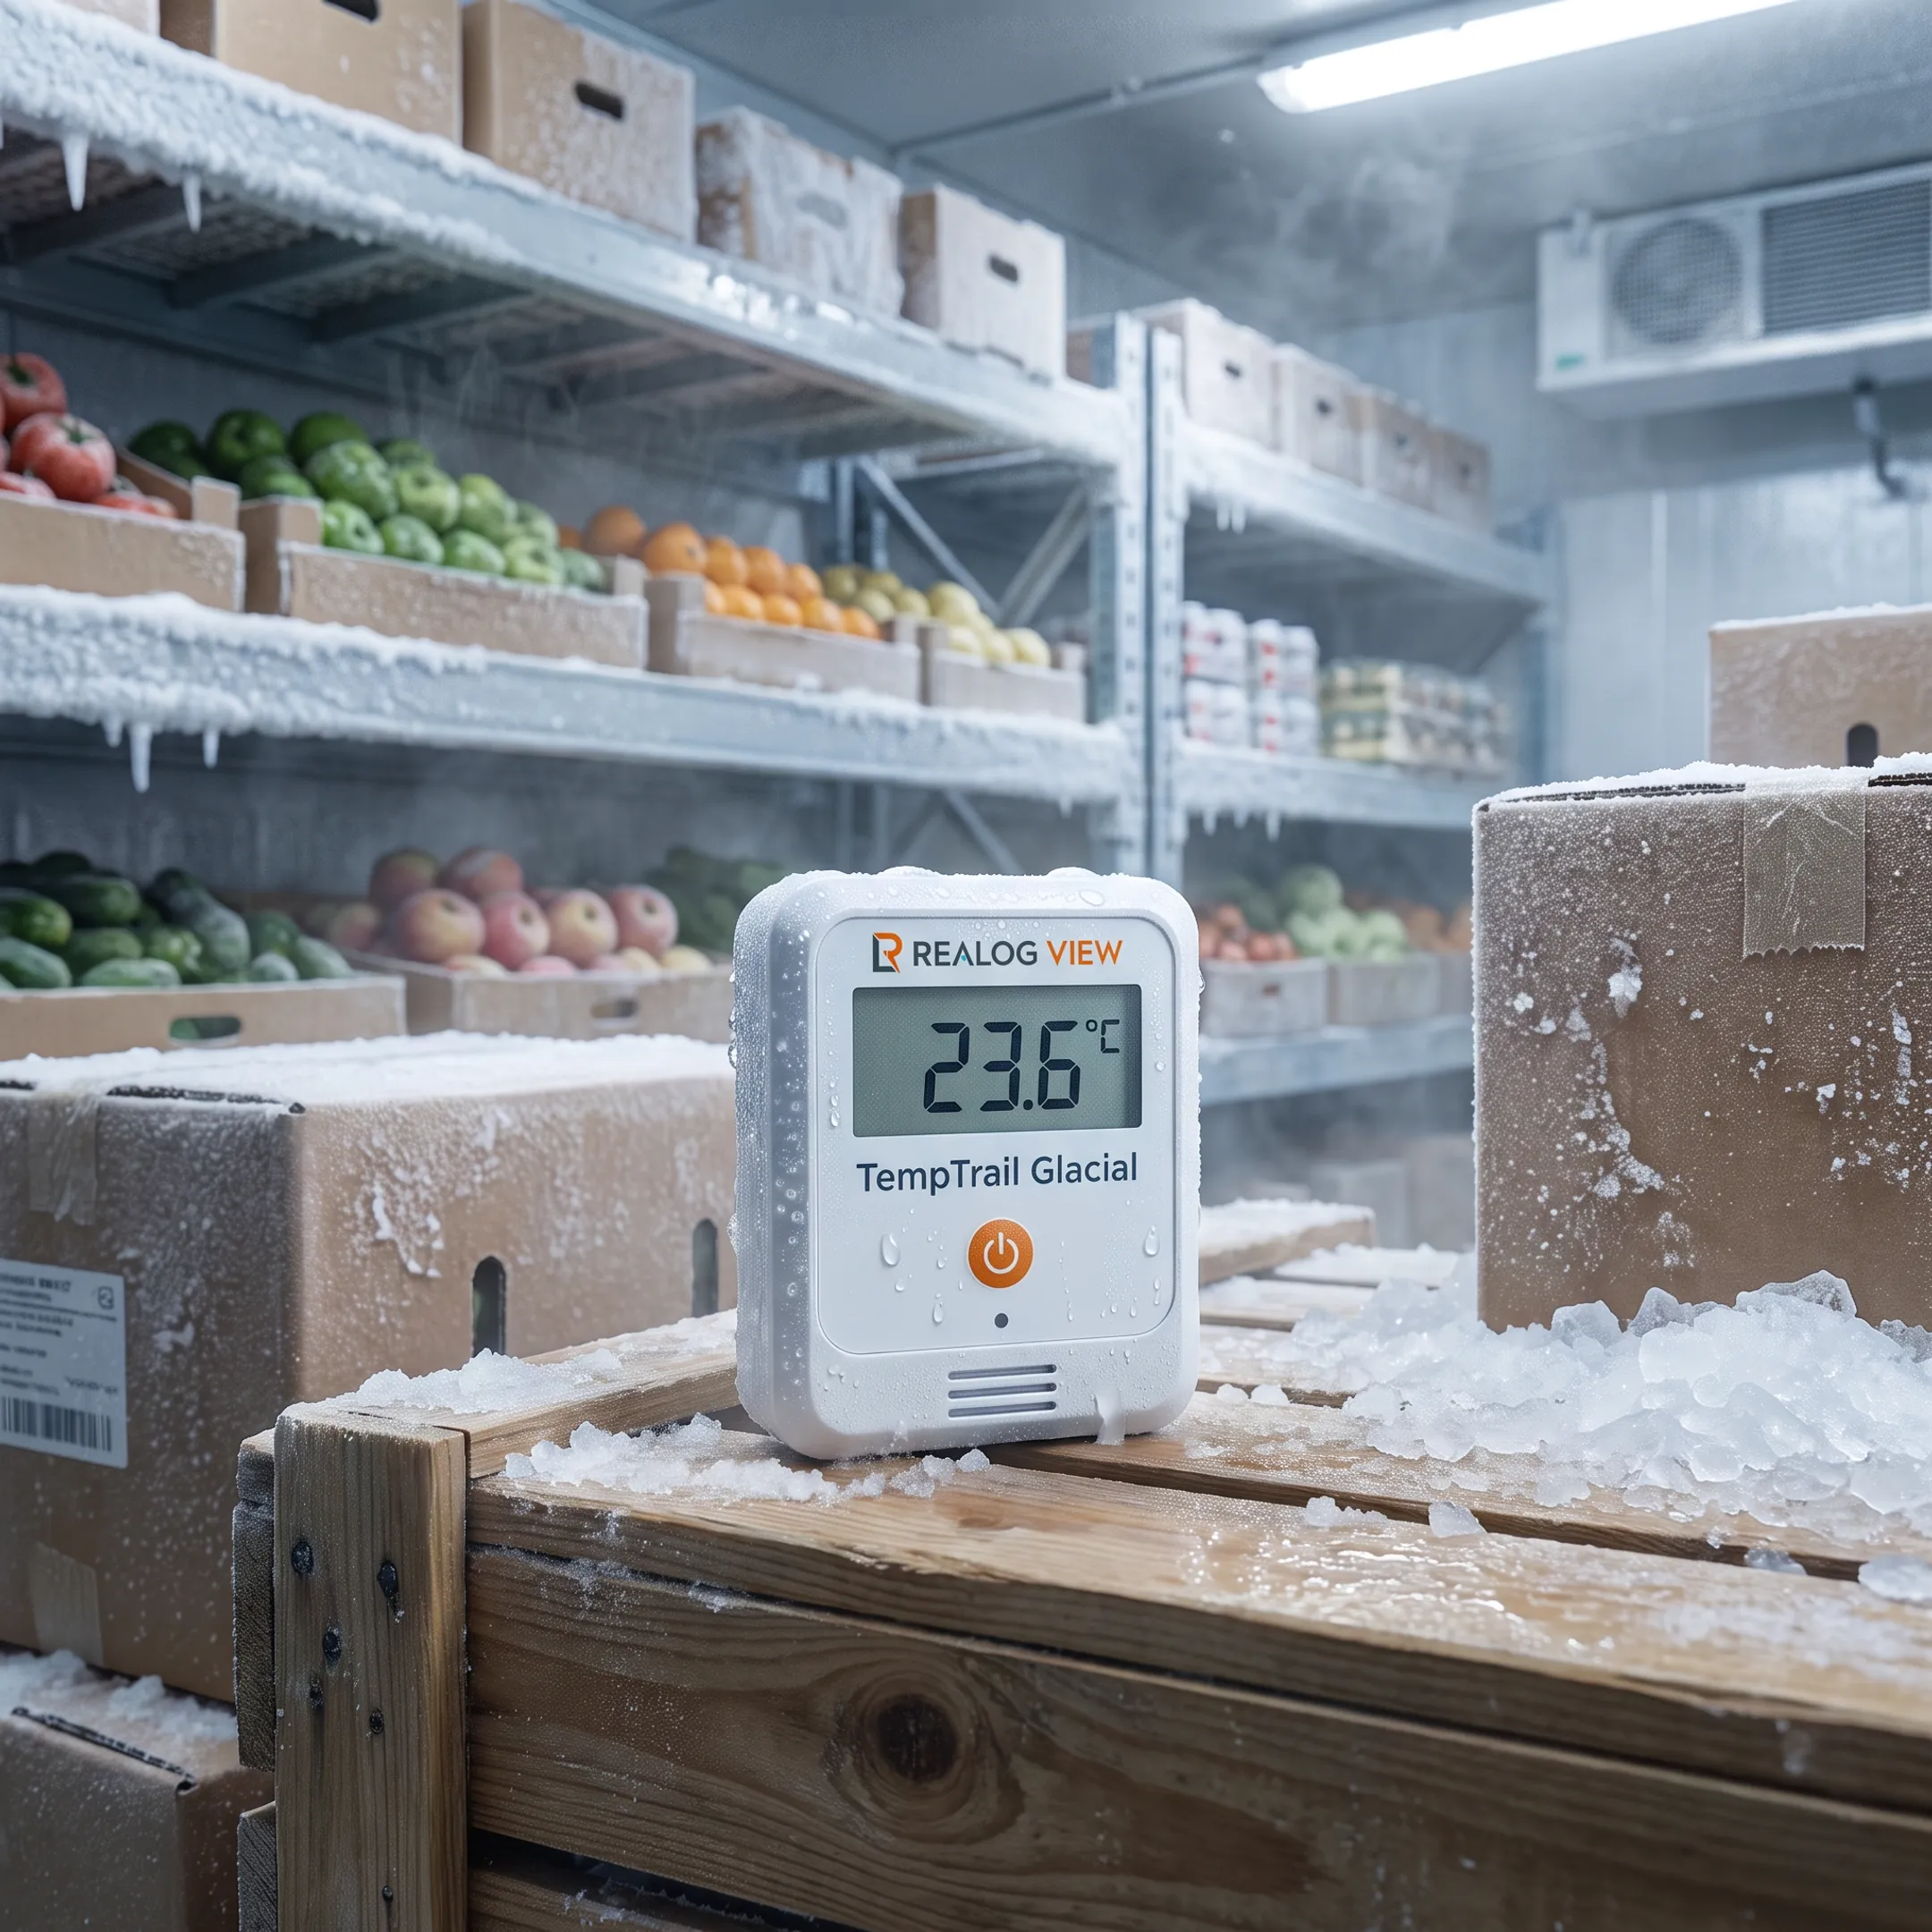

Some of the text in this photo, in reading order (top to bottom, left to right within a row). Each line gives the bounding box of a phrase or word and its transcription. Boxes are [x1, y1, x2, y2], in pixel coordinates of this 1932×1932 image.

[912, 940, 1038, 967] REALOG
[1046, 939, 1123, 967] VIEW
[923, 1020, 1081, 1114] 23.6
[855, 1151, 1137, 1197] TempTrail Glacial
